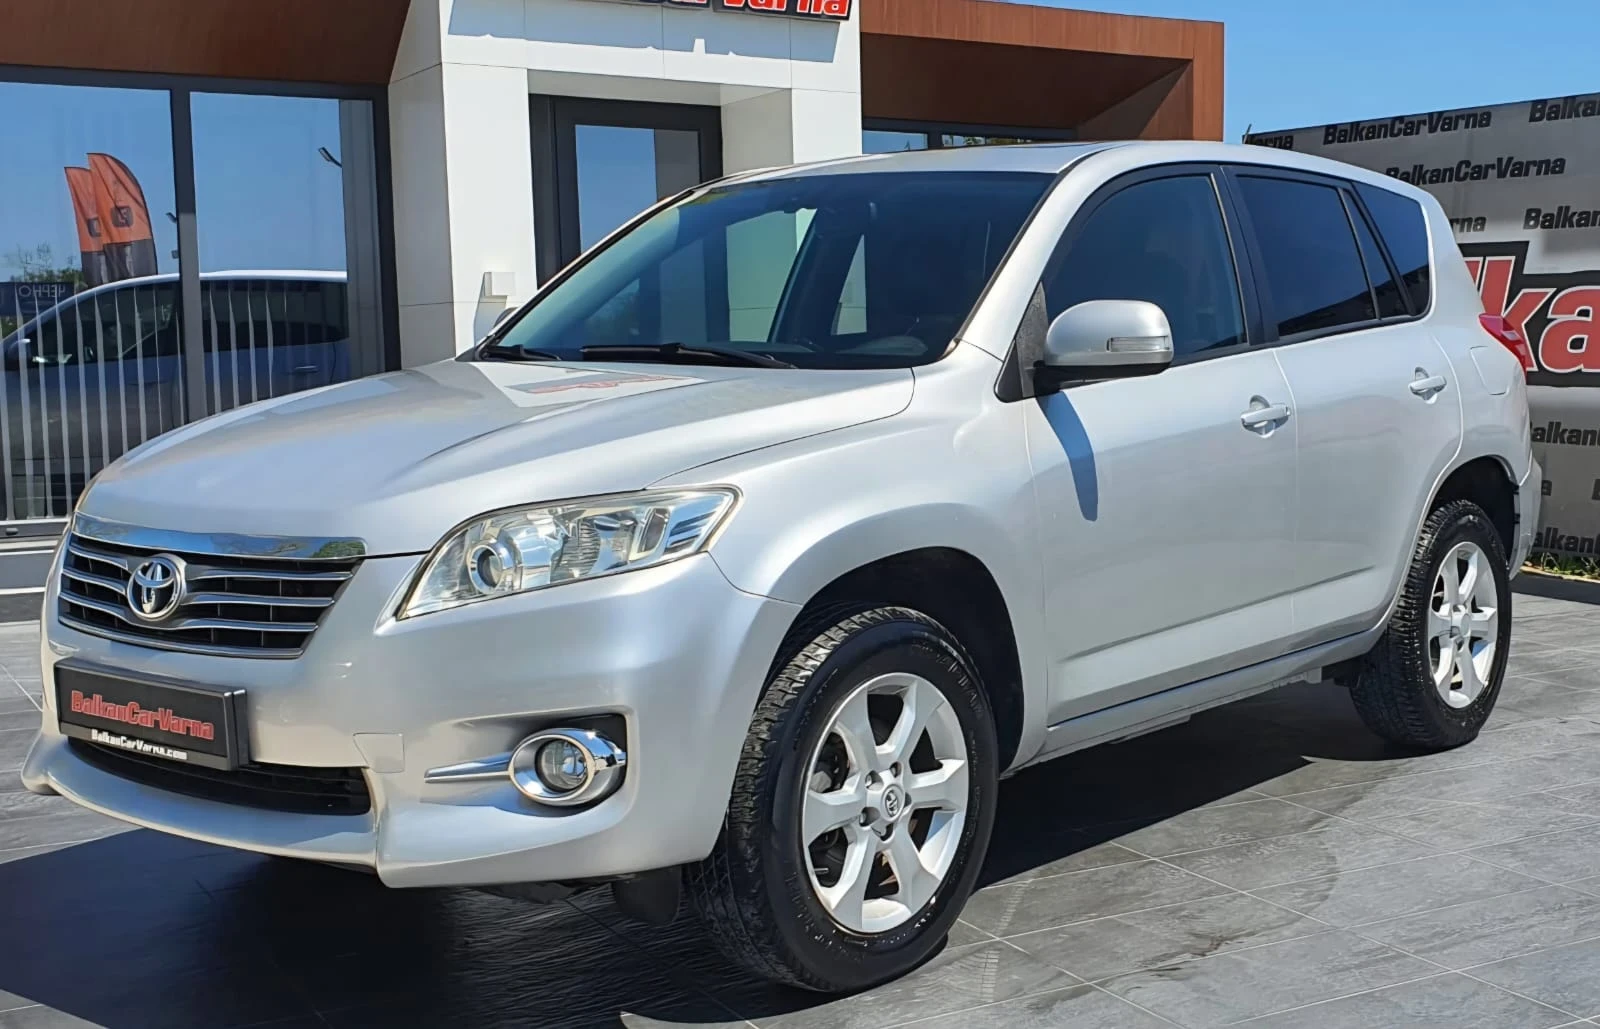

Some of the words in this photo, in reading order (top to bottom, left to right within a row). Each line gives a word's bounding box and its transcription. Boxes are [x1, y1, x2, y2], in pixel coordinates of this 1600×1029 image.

[1529, 97, 1600, 122] Balka
[1323, 110, 1492, 146] BalkanCarVarna
[71, 690, 214, 740] BalkanCarVarna
[91, 729, 188, 760] BalkanCarVarna.com
